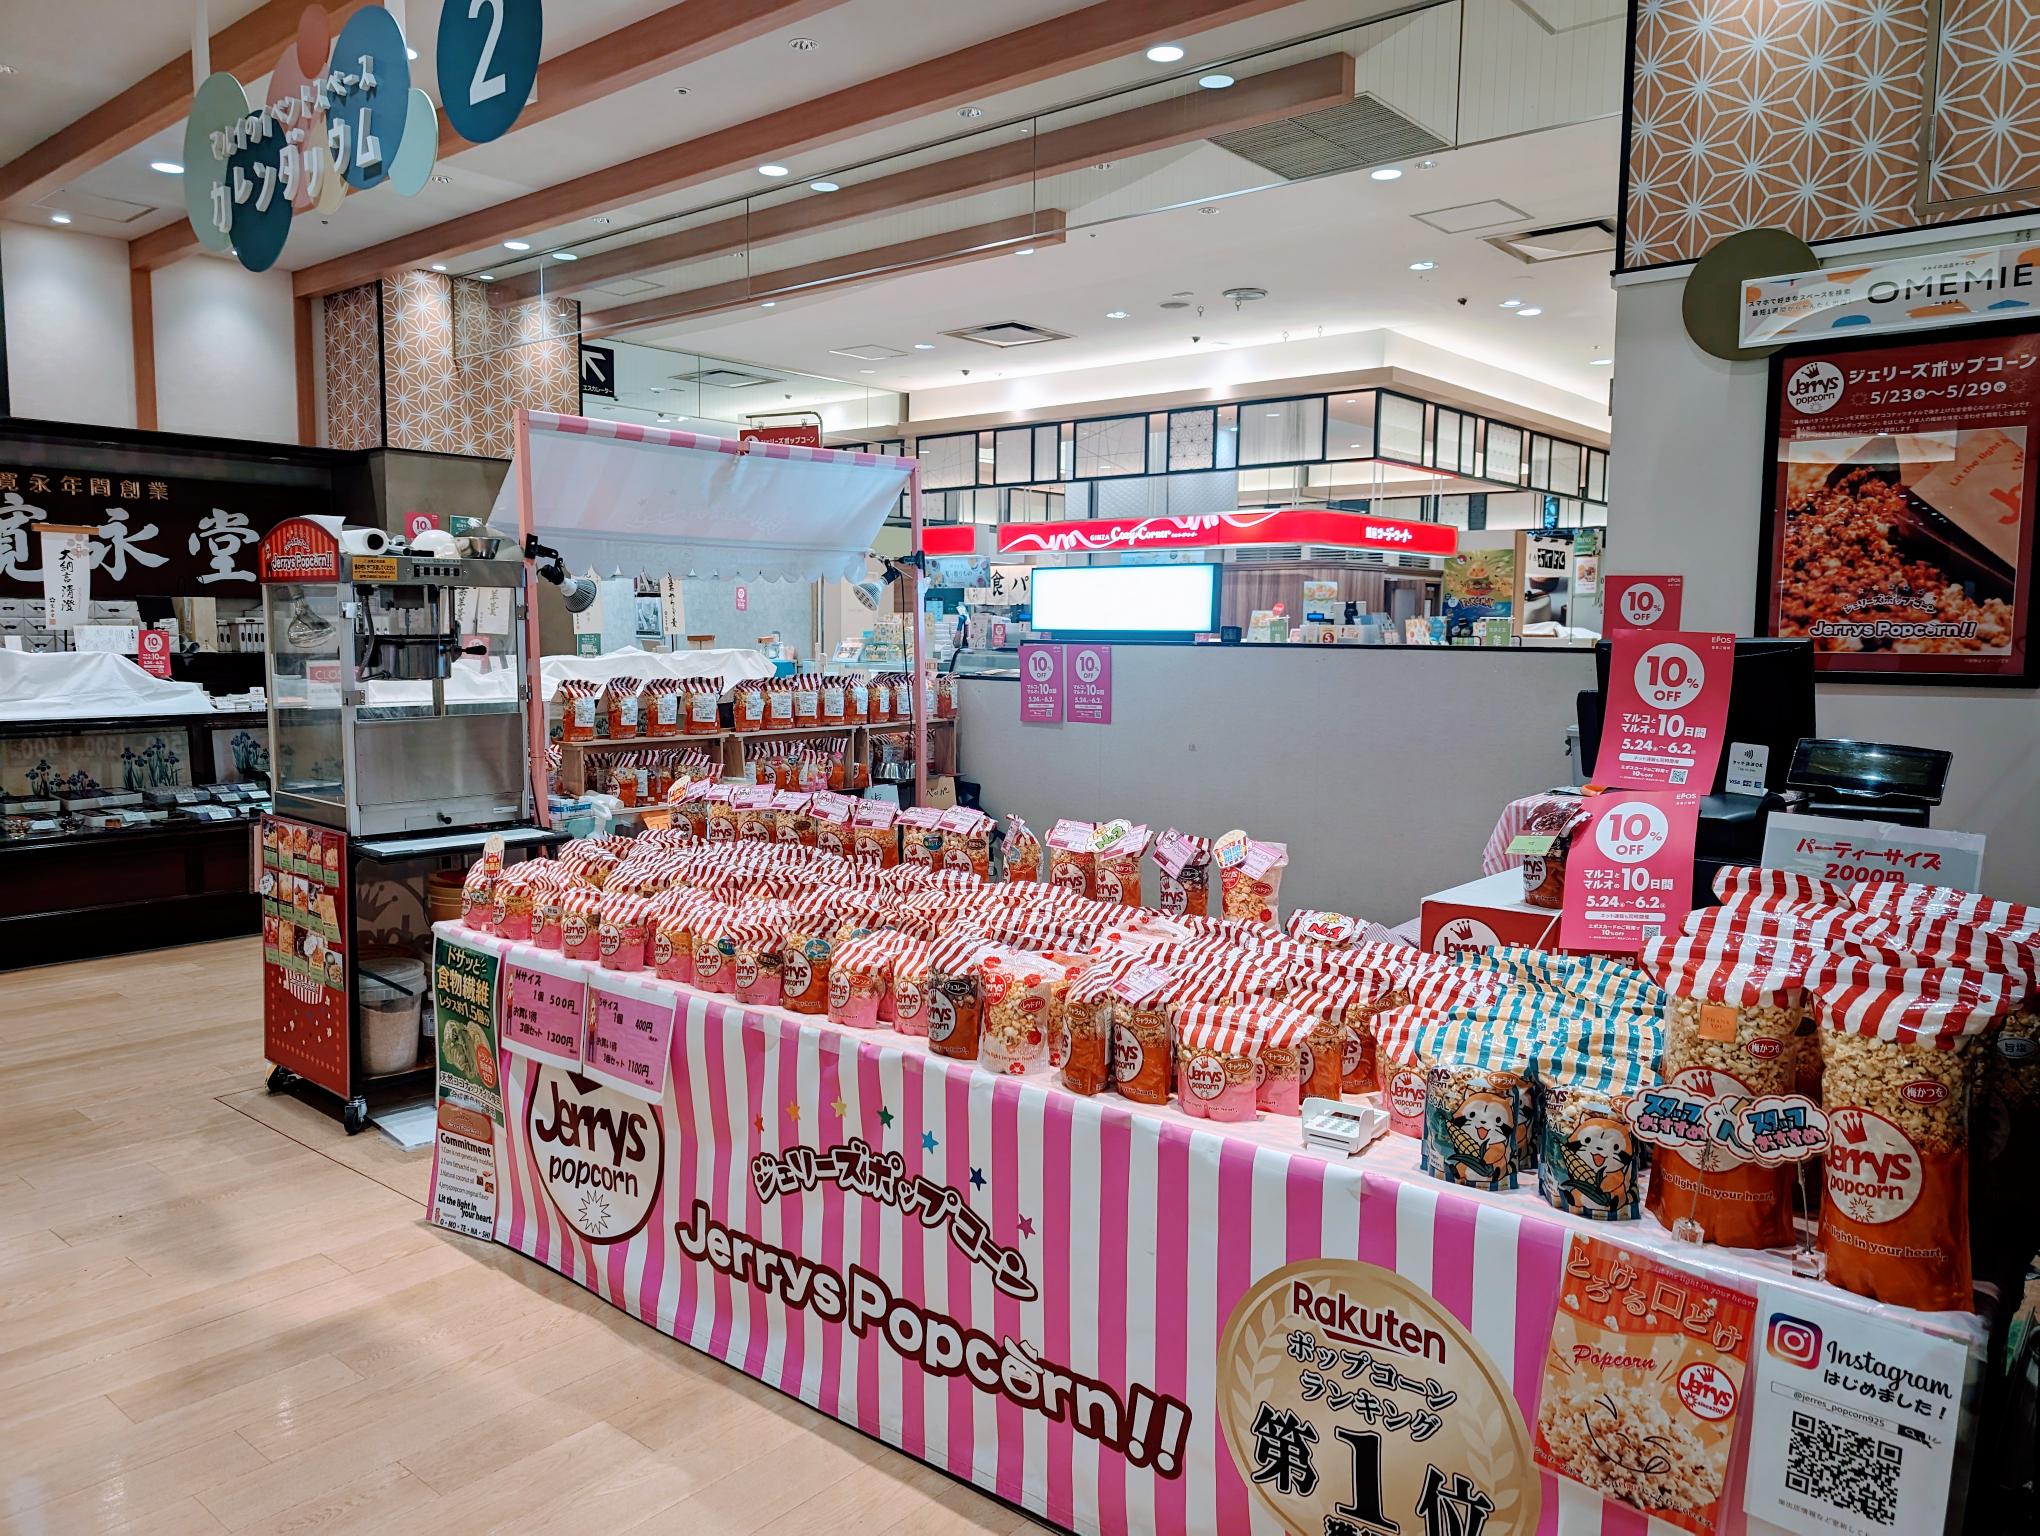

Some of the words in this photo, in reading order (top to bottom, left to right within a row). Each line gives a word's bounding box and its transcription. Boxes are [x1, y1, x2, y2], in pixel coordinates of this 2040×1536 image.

[468, 0, 506, 106] 2
[210, 107, 382, 233] カレンダリウム
[1867, 263, 2033, 304] OMEMIE
[1849, 354, 2037, 385] ジェリーズポップコーン
[582, 384, 614, 394] エスカレーター
[1790, 376, 1839, 396] Jerrys
[1795, 392, 1835, 406] popcorn
[1090, 533, 1110, 541] GINZA
[272, 554, 296, 570] Jerrys
[1627, 591, 1661, 612] 10%
[1711, 636, 1732, 644] EPOS
[1810, 621, 1873, 638] Jerrys
[1875, 620, 1978, 639] Popcorn!!
[1647, 656, 1699, 689] 10%
[1654, 690, 1681, 702] OFF
[1621, 724, 1656, 734] マルオの
[1623, 713, 1657, 724] マルコと
[1609, 813, 1662, 842] 10%
[1616, 845, 1644, 855] OFF
[1797, 837, 1941, 871] パーティーサイズ
[1584, 869, 1620, 879] マルコと
[1825, 862, 1905, 884] 2000円
[1584, 880, 1620, 890] マルオの
[564, 924, 585, 935] Jerrys
[1307, 923, 1344, 940] No.1
[447, 946, 482, 974] ドサッと
[437, 965, 489, 1009] 食物繊維
[515, 969, 541, 987] Mサイズ
[439, 994, 491, 1028] レタス約1.5個分
[533, 990, 544, 1002] 1個
[550, 995, 575, 1010] 500円
[513, 1006, 537, 1023] お買い得
[614, 1012, 624, 1024] 1個
[635, 1019, 653, 1033] 400円
[1134, 1016, 1160, 1026] キャラメル
[519, 1022, 543, 1038] 3個セット
[547, 1030, 573, 1047] 1300円
[1267, 1051, 1292, 1063] キャラメル
[1750, 1042, 1780, 1055] 梅かつを
[2005, 1041, 2027, 1053] 旨塩
[483, 1072, 493, 1083] ゼロ
[628, 1059, 649, 1077] 1100円
[1189, 1066, 1222, 1083] Jerrys
[1228, 1061, 1251, 1072] キャラメル
[1191, 1081, 1220, 1090] popcorn
[1391, 1084, 1425, 1101] Jerrys
[1905, 1086, 1944, 1099] 梅かつを
[1642, 1094, 1705, 1119] スタッフ
[535, 1081, 648, 1168] Jerrys
[1638, 1114, 1708, 1142] おすすめ
[1746, 1106, 1806, 1134] スタッフ
[441, 1132, 491, 1158] Commitment
[1753, 1126, 1828, 1152] おすすめ
[549, 1155, 638, 1198] popcorn
[1674, 1174, 1697, 1192] light
[1700, 1185, 1711, 1195] in
[1713, 1188, 1744, 1201] your
[1830, 1175, 1904, 1201] popcorn
[438, 1193, 446, 1204] Lit
[447, 1195, 456, 1207] the
[456, 1198, 470, 1211] light
[471, 1202, 477, 1212] in
[461, 1208, 475, 1220] your
[476, 1211, 493, 1225] heart.
[751, 1137, 1038, 1301] ジェリーズポップコーン
[1831, 1226, 1853, 1244] light
[1854, 1235, 1866, 1249] in
[1868, 1241, 1902, 1258] your
[1680, 1273, 1699, 1288] light
[1700, 1280, 1710, 1290] in
[1710, 1285, 1731, 1299] your
[1567, 1247, 1743, 1352] とろける口どけ
[1293, 1281, 1446, 1365] Rakuten
[675, 1199, 847, 1323] Jerrys
[848, 1264, 1193, 1480] Popcorn!!
[1572, 1344, 1657, 1370] Popcorn
[1286, 1331, 1458, 1411] ポップコーン
[1827, 1341, 1953, 1400] Instagram
[1681, 1372, 1733, 1408] Jerrys
[1823, 1369, 1947, 1420] はじめました！
[1300, 1369, 1443, 1441] ランキング
[1697, 1400, 1727, 1415] since2007
[1793, 1391, 1885, 1428] @jerres_popcorn925
[1251, 1401, 1495, 1536] 第1位
